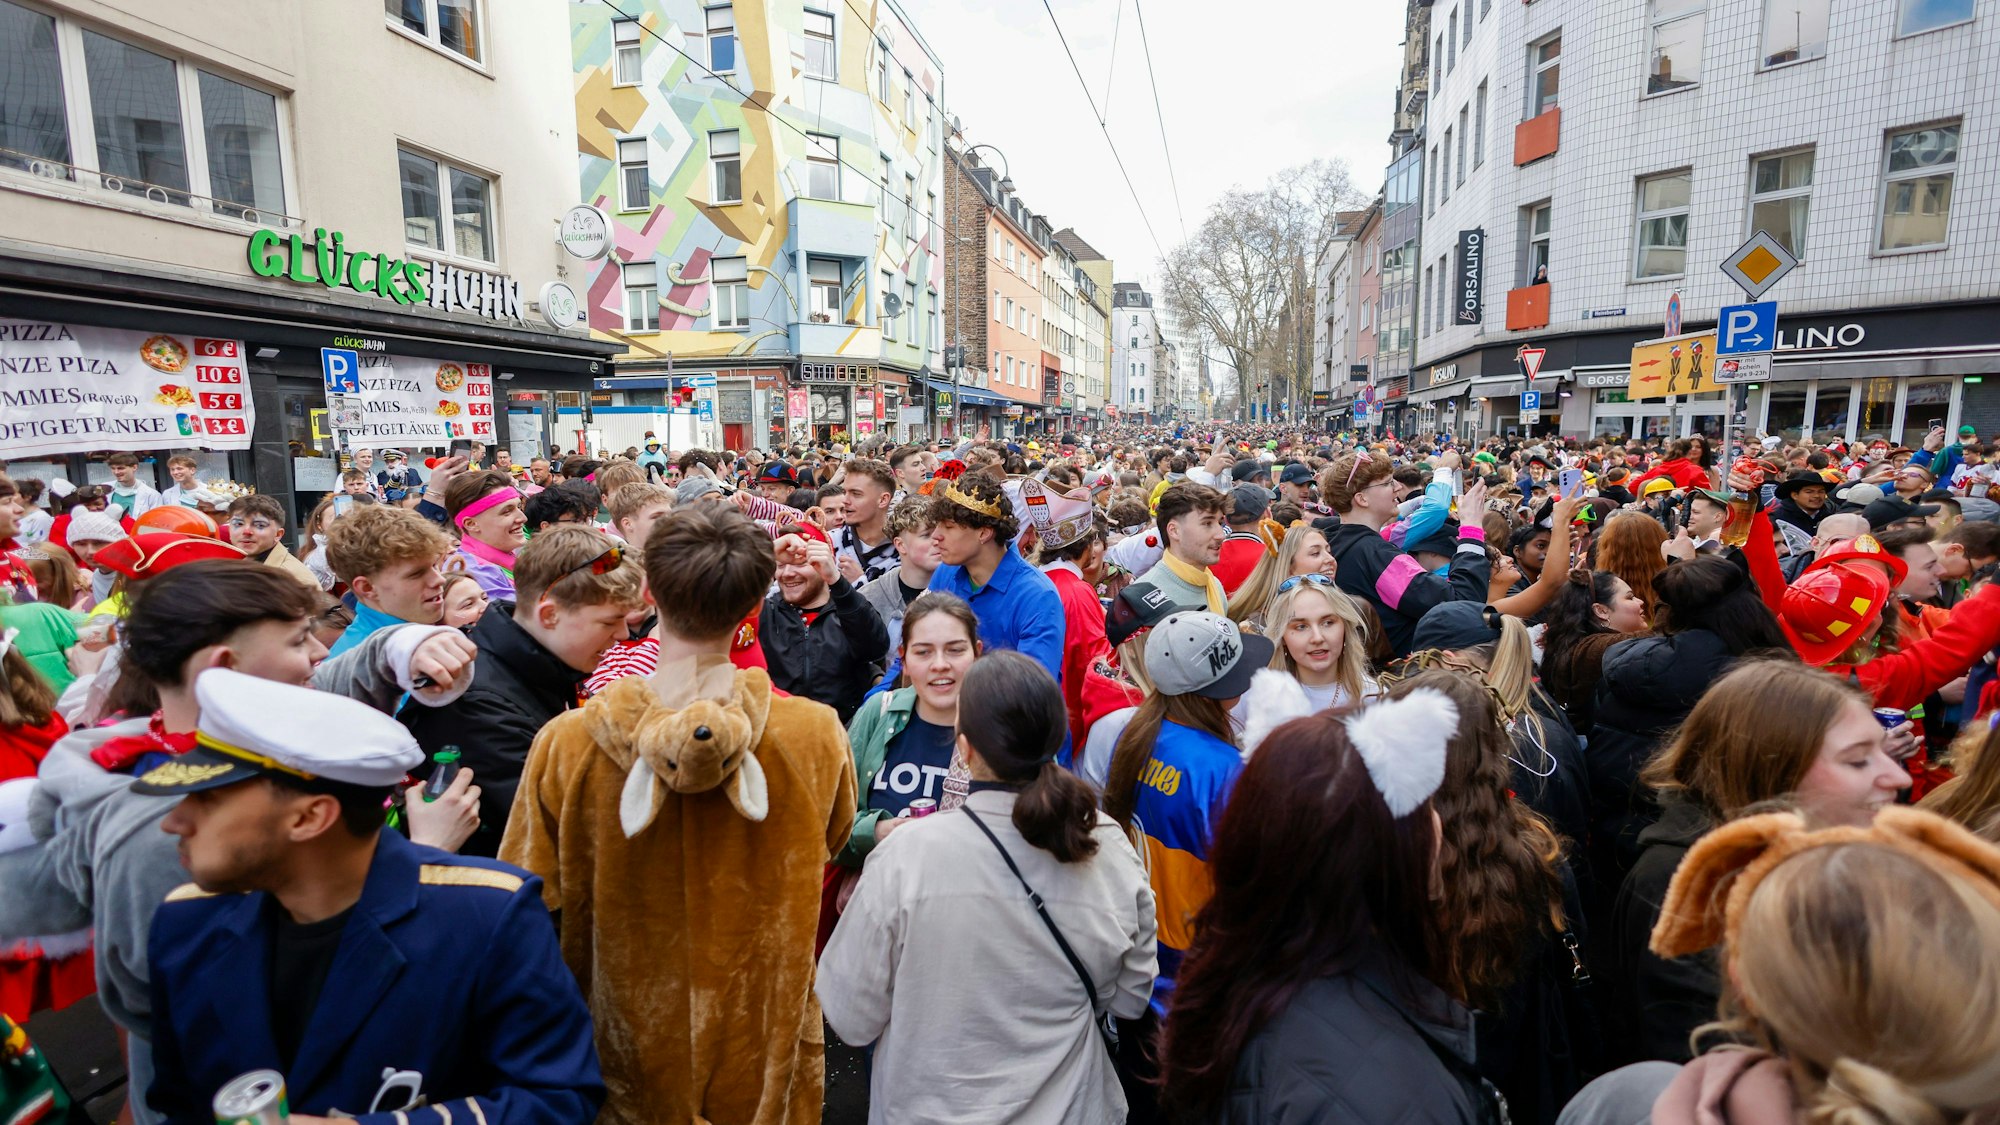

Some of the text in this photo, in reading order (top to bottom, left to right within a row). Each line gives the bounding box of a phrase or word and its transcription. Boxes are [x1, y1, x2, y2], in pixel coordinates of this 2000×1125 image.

[564, 231, 603, 242] GLÜCKSHUHN
[248, 227, 525, 321] GLÜCKSHUHN
[1459, 233, 1480, 322] BORSALINO
[1726, 310, 1758, 349] P
[204, 341, 235, 357] 6 €
[334, 335, 386, 351] GLÜCKSHUHN
[199, 367, 239, 383] 10 €
[328, 354, 348, 388] P
[471, 364, 486, 376] 6 €
[0, 387, 82, 407] MMES
[469, 384, 490, 396] 10 €
[208, 394, 236, 409] 5 €
[1524, 393, 1536, 408] P
[475, 404, 490, 416] 5 €
[211, 419, 238, 434] 3 €
[477, 422, 483, 434] 3
[1208, 637, 1239, 677] Nets
